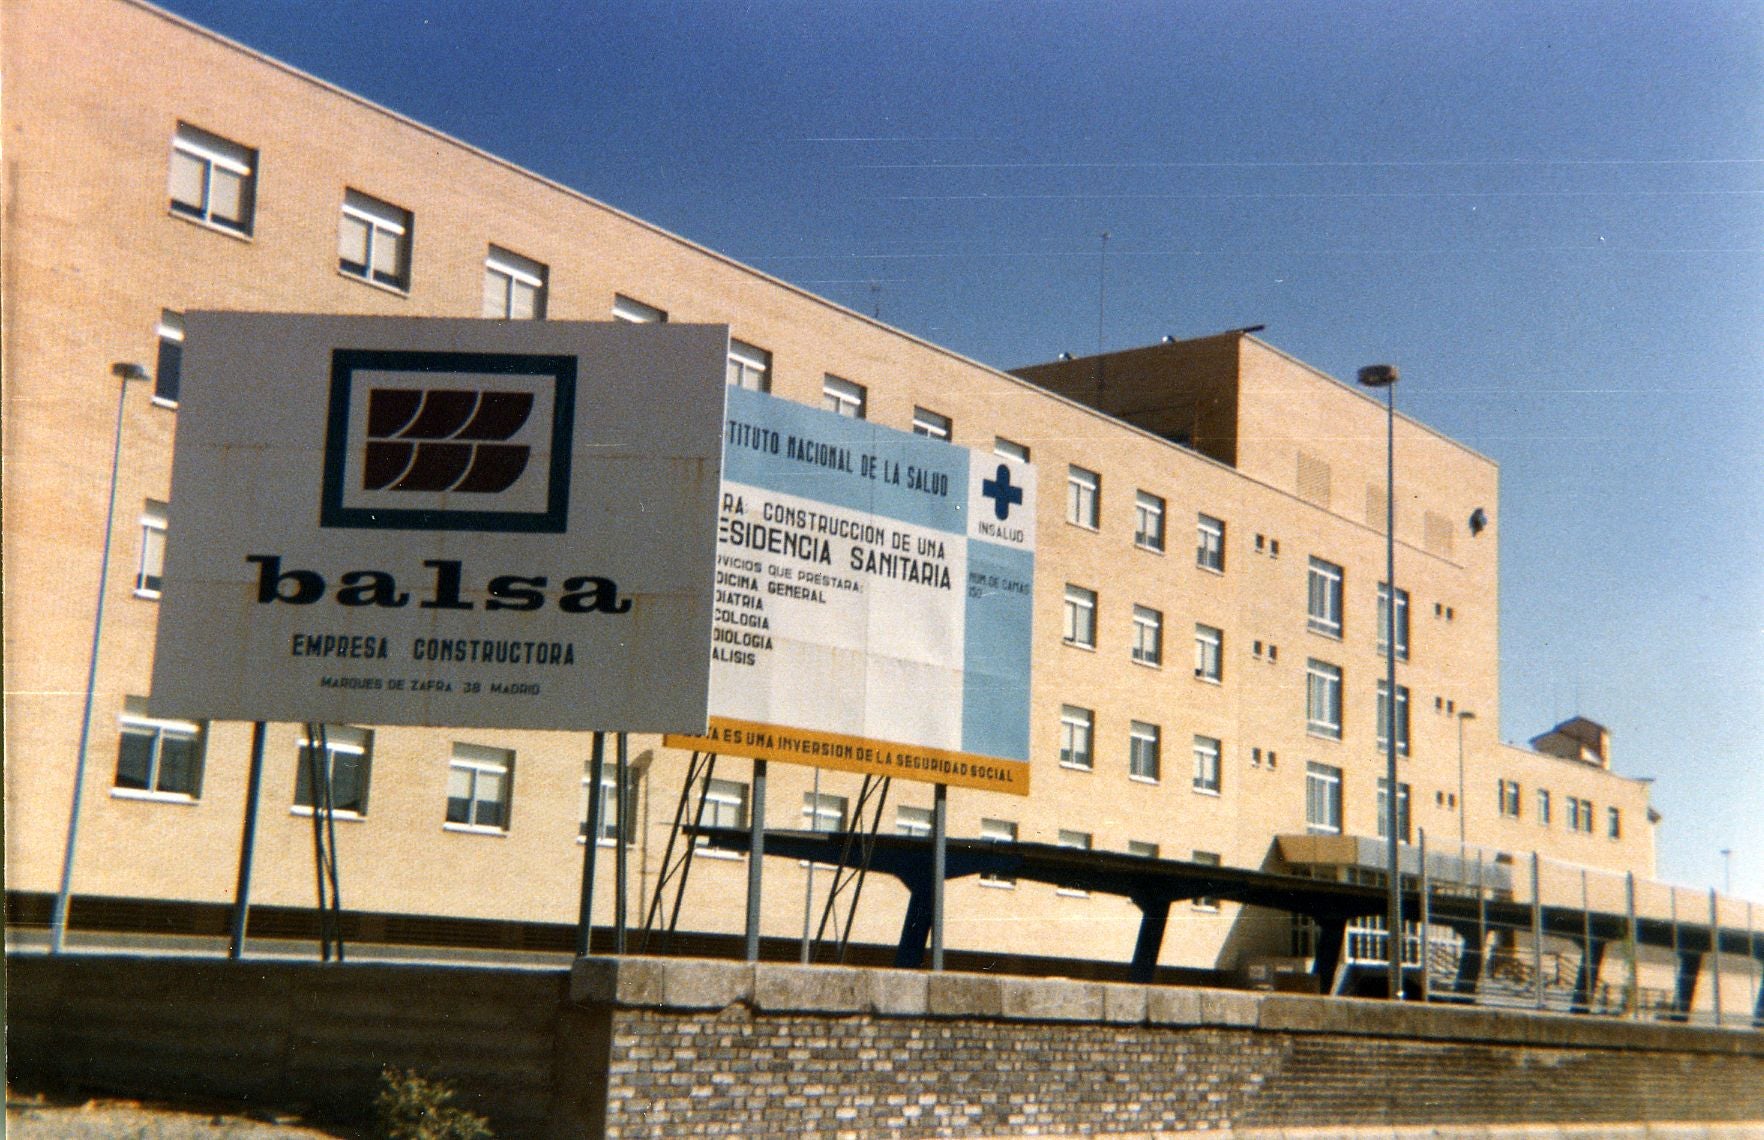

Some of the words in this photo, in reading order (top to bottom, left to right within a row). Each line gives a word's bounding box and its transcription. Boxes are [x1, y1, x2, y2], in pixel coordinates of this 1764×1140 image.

[729, 420, 779, 454] TITUTO
[788, 434, 853, 473] NACIONAL
[861, 454, 877, 479] DE
[884, 460, 900, 485] LA
[907, 466, 948, 497] SALUD
[723, 493, 744, 515] RA
[763, 502, 885, 546] CONSTRUCCION
[892, 531, 910, 551] DE
[918, 537, 945, 560] UNA
[978, 521, 1024, 543] INSALUD
[246, 554, 633, 614] balsa
[768, 564, 793, 579] QUE
[850, 546, 951, 590] SANITARIA
[768, 581, 826, 604] GENERAL
[292, 634, 388, 660] EMPRESA
[413, 638, 575, 666] CONSTRUCTORA
[712, 647, 756, 666] ALISIS
[320, 676, 383, 691] MARQUES
[388, 679, 404, 691] DE
[410, 680, 452, 693] ZAFRA
[464, 683, 481, 694] 38
[490, 682, 540, 696] MADRID
[723, 728, 742, 744] ES
[745, 731, 774, 750] UNA
[778, 736, 853, 760] INVERSION
[856, 749, 873, 763] DE
[876, 750, 892, 766] LA
[896, 753, 967, 776] SEGURIDAD
[970, 764, 1014, 783] SOCIAL
